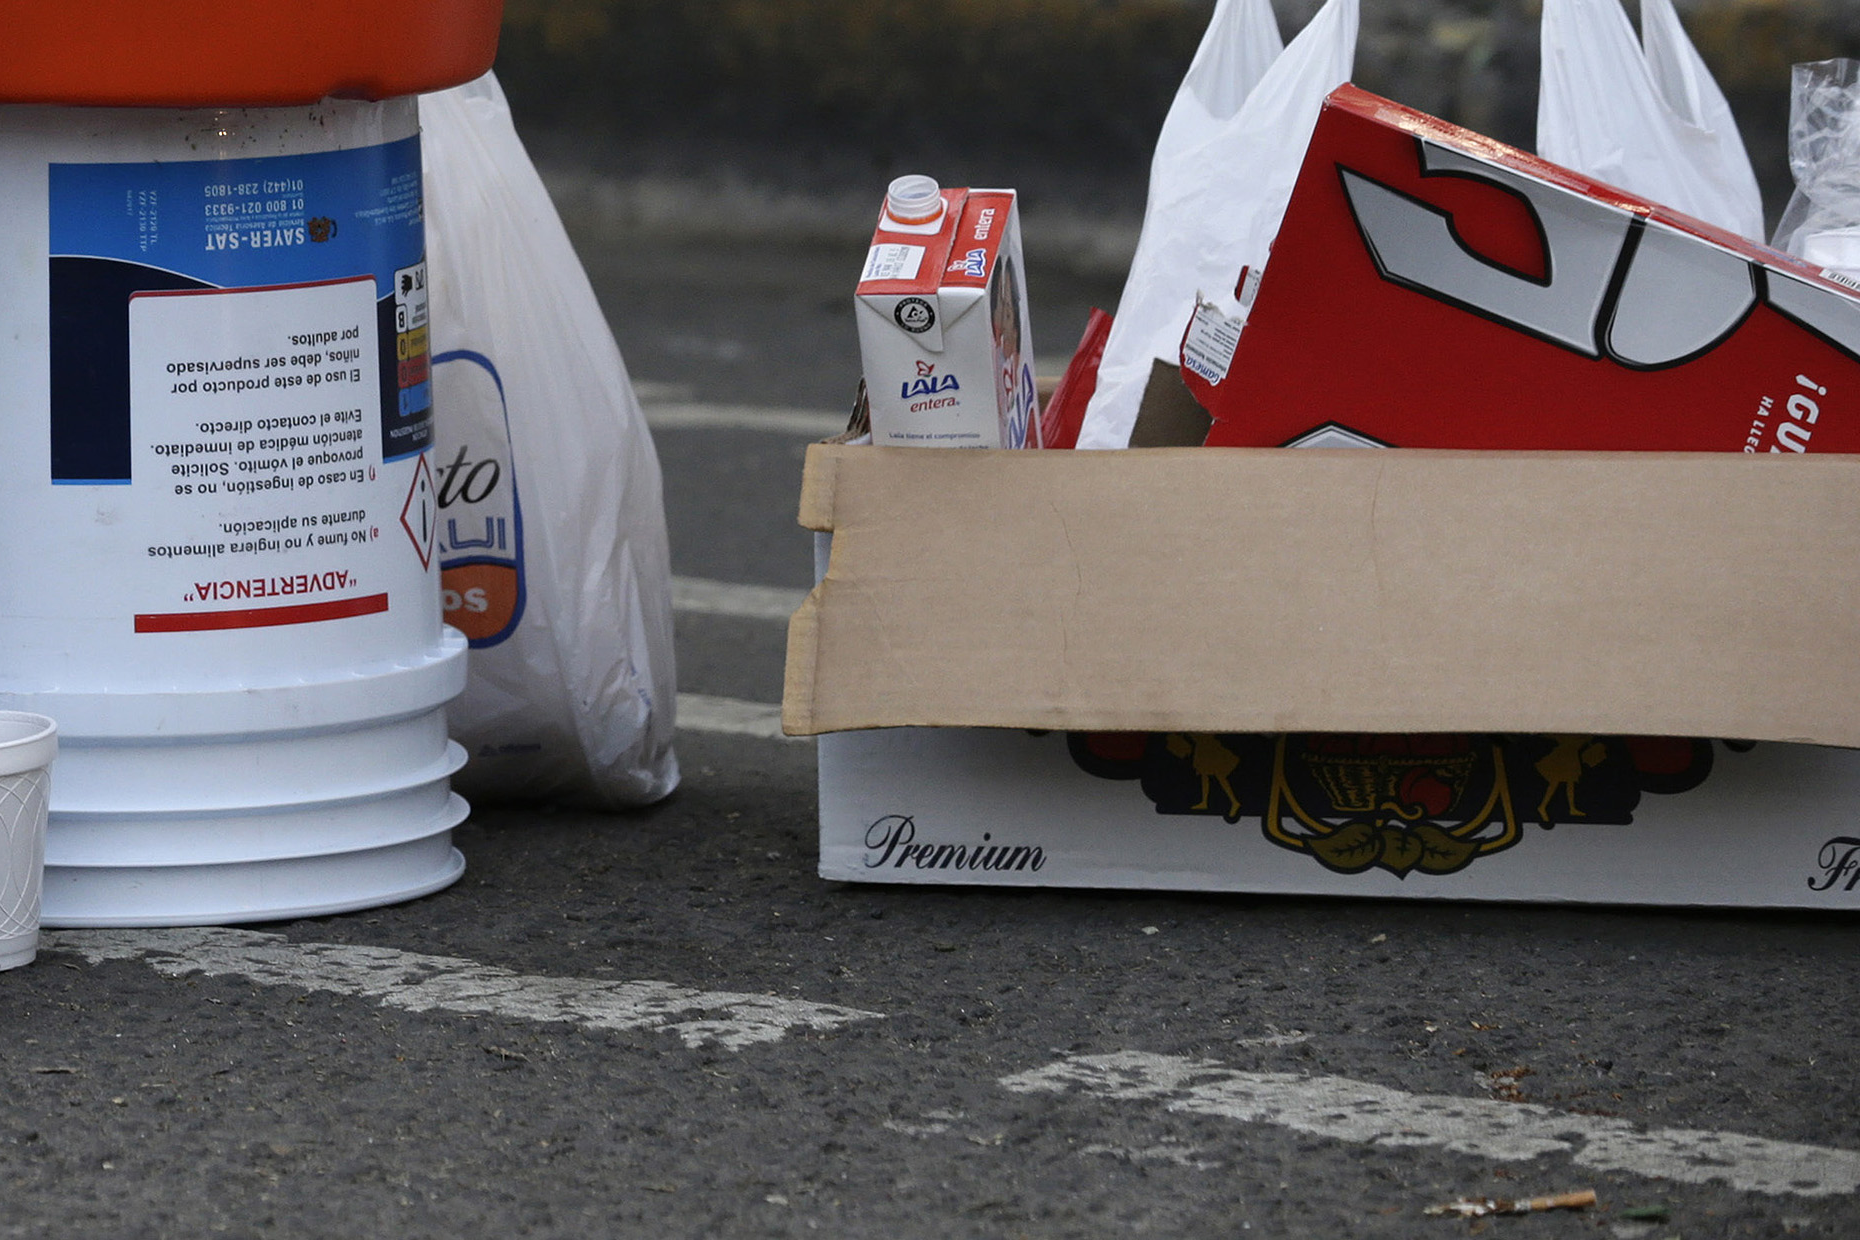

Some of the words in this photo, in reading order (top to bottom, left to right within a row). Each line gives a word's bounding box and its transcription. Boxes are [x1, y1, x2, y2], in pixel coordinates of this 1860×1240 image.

[204, 182, 259, 198] 238-1805
[263, 178, 304, 195] 01(442)
[205, 201, 262, 216] 021-9333
[266, 200, 287, 212] 800
[292, 198, 304, 211] 01
[205, 228, 305, 251] SAYER-SAT
[287, 330, 338, 347] adultos.
[341, 325, 359, 340] por
[263, 355, 286, 368] ser
[290, 351, 322, 366] debe
[326, 348, 360, 363] niños,
[166, 357, 261, 376] supervisado
[1186, 353, 1220, 384] Gamesa
[274, 375, 302, 388] este
[306, 372, 322, 386] de
[325, 372, 347, 383] uso
[350, 369, 361, 382] El
[170, 380, 198, 395] por
[202, 375, 270, 394] producto
[901, 373, 960, 401] LALA
[910, 395, 957, 413] entera
[1756, 395, 1774, 417] HA
[320, 411, 331, 427] el
[334, 409, 362, 423] Evite
[1769, 373, 1828, 454] ¡GU
[195, 417, 253, 434] directo.
[257, 414, 317, 430] contacto
[237, 438, 255, 453] de
[259, 435, 309, 451] médica
[313, 429, 363, 446] atención
[150, 440, 232, 459] inmediato.
[307, 446, 363, 466] provoque
[171, 461, 230, 477] Solicite
[234, 457, 288, 473] vómito.
[292, 454, 303, 470] el
[298, 474, 314, 488] de
[317, 473, 347, 485] caso
[349, 469, 365, 482] En
[174, 484, 193, 495] se
[198, 483, 217, 494] no
[222, 476, 294, 496] ingestión,
[302, 517, 318, 527] su
[321, 509, 366, 525] durante
[219, 517, 297, 536] aplicación.
[369, 525, 379, 540] a)
[284, 538, 302, 549] no
[305, 535, 315, 548] y
[317, 532, 348, 546] fume
[351, 529, 367, 544] No
[148, 541, 225, 559] alimentos
[230, 536, 281, 554] ingiera
[864, 814, 1047, 872] Premium
